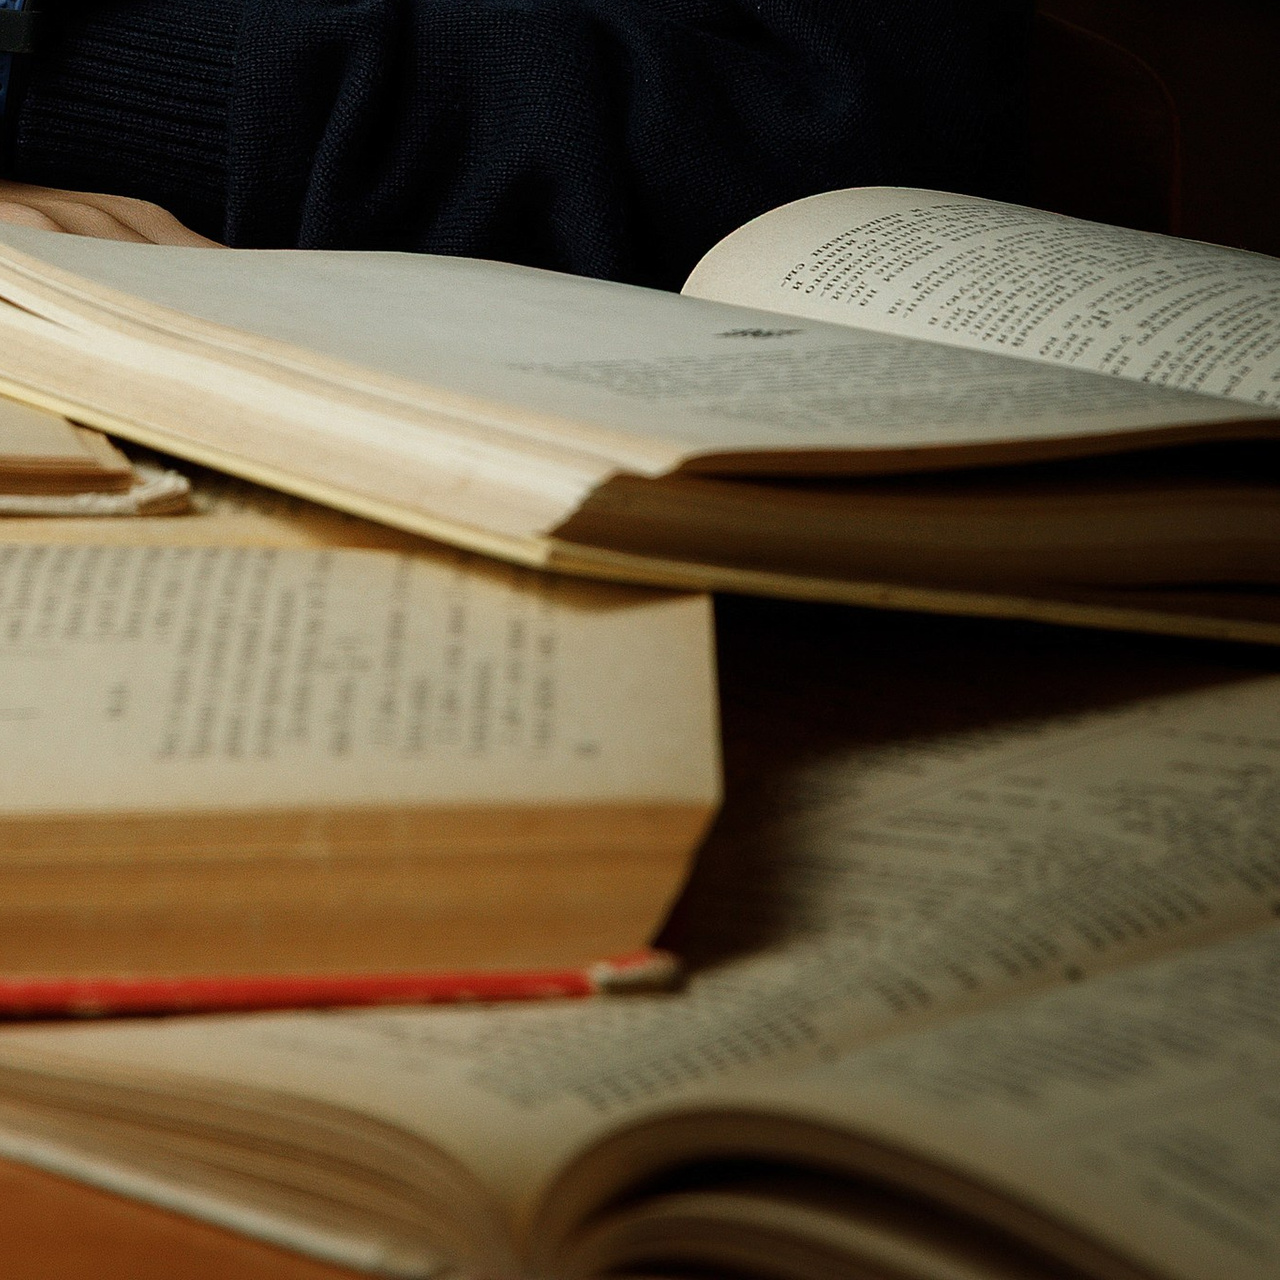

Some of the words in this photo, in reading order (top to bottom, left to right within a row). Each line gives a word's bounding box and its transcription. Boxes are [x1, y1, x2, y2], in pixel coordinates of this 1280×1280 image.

[809, 239, 855, 271] иначе
[874, 240, 931, 275] вполне
[889, 236, 920, 253] они
[802, 252, 854, 294] своего
[830, 256, 884, 300] сидели
[883, 245, 941, 282] вихрем
[911, 245, 985, 290] садиться
